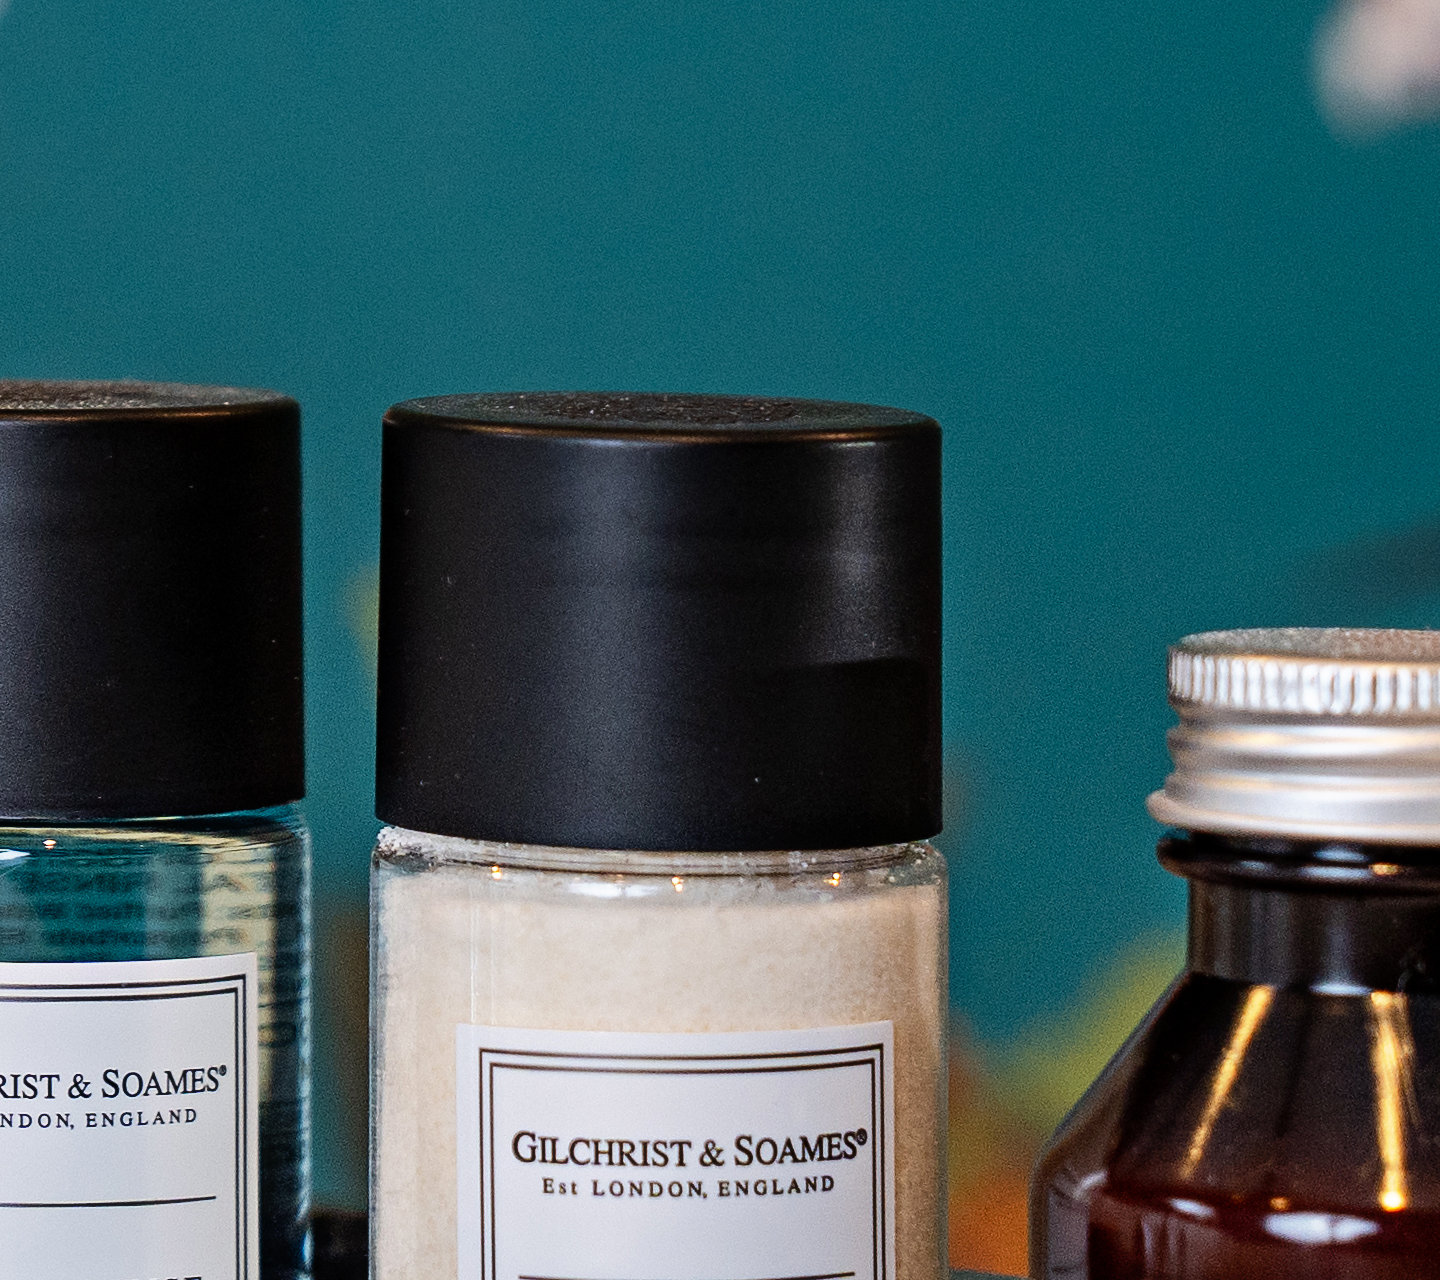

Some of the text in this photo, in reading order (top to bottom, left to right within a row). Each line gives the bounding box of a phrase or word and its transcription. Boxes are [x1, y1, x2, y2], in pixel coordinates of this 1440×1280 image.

[66, 1072, 93, 1100] &
[84, 1107, 199, 1129] ENGLAND
[511, 1129, 694, 1169] GILCHRIST
[697, 1138, 726, 1169] &
[541, 1173, 836, 1201] Est LONDON, ENGLAND
